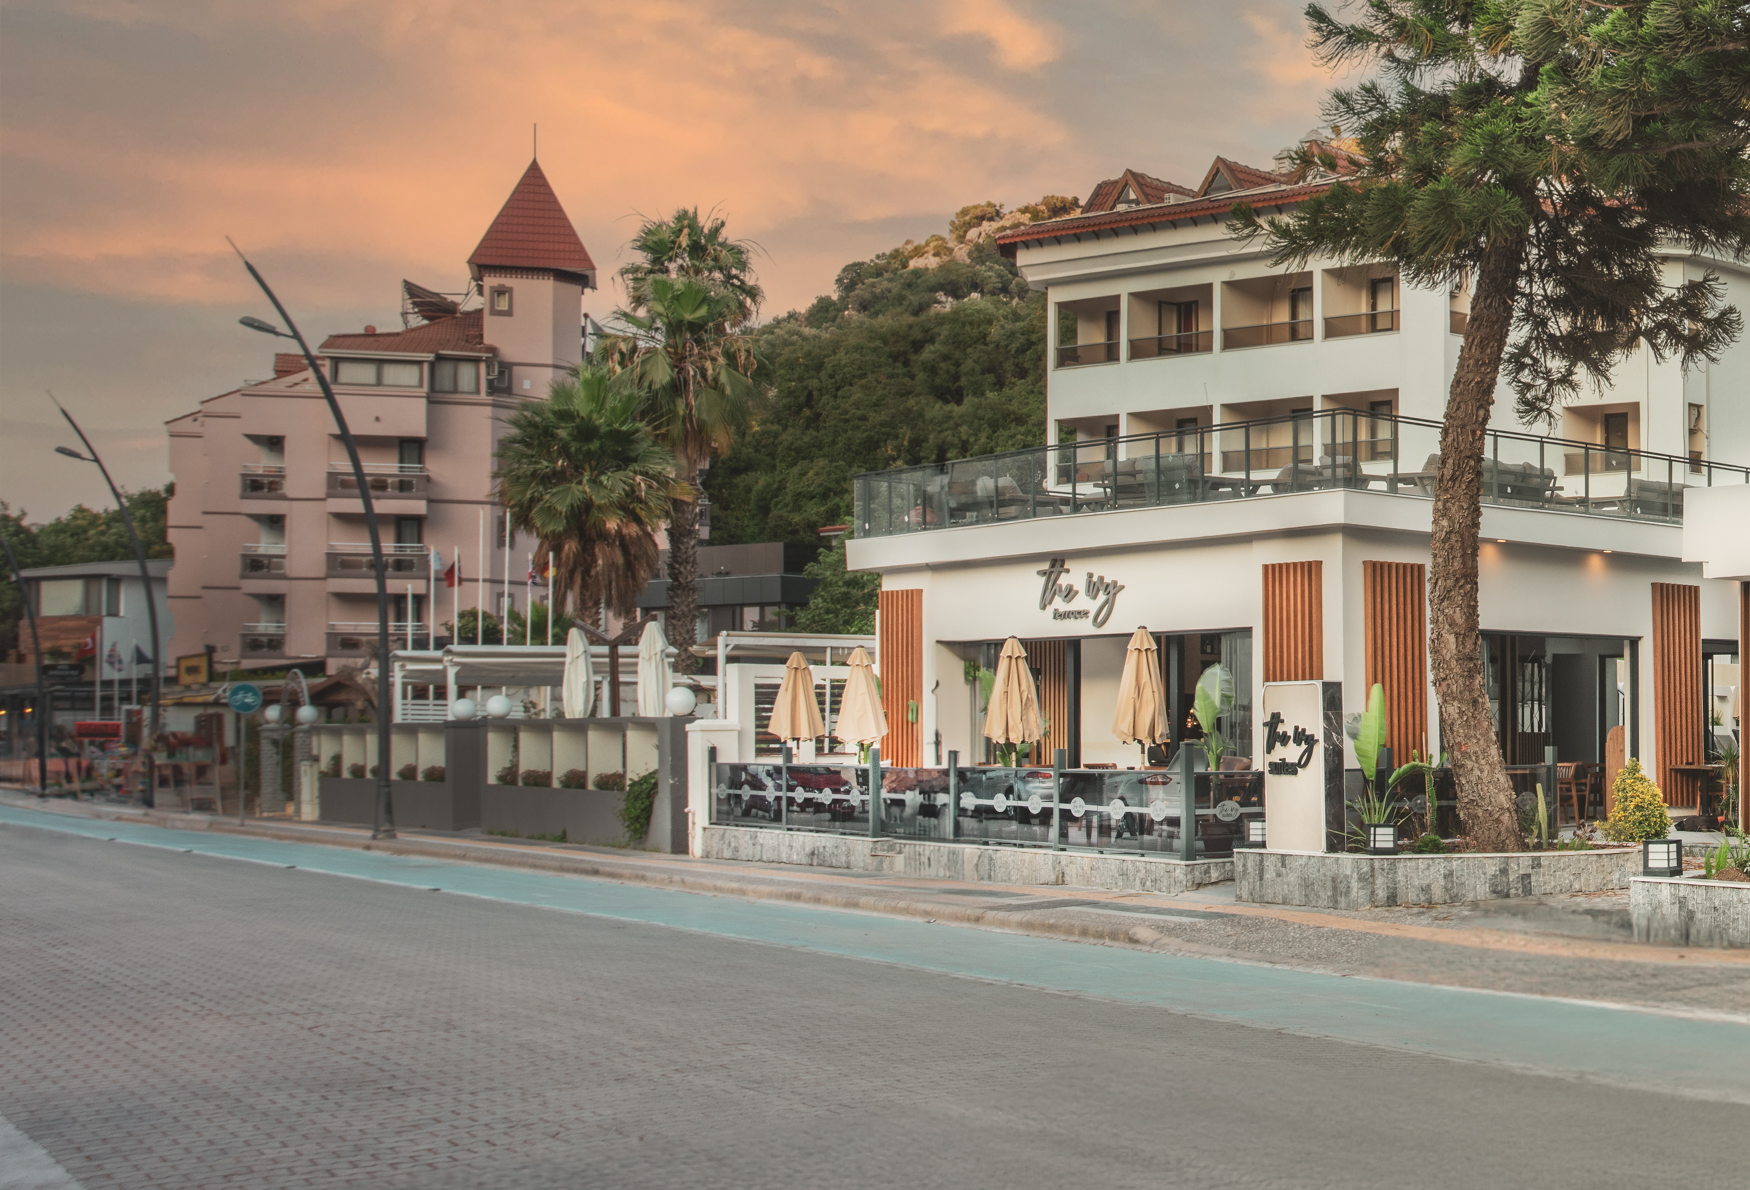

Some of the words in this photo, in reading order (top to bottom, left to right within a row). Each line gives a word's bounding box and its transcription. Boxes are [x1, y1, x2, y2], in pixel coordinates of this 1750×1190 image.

[1036, 558, 1079, 611] the
[1085, 572, 1125, 628] ivy
[1262, 712, 1291, 754] the
[1293, 725, 1319, 769] ivy
[1268, 757, 1299, 775] suites
